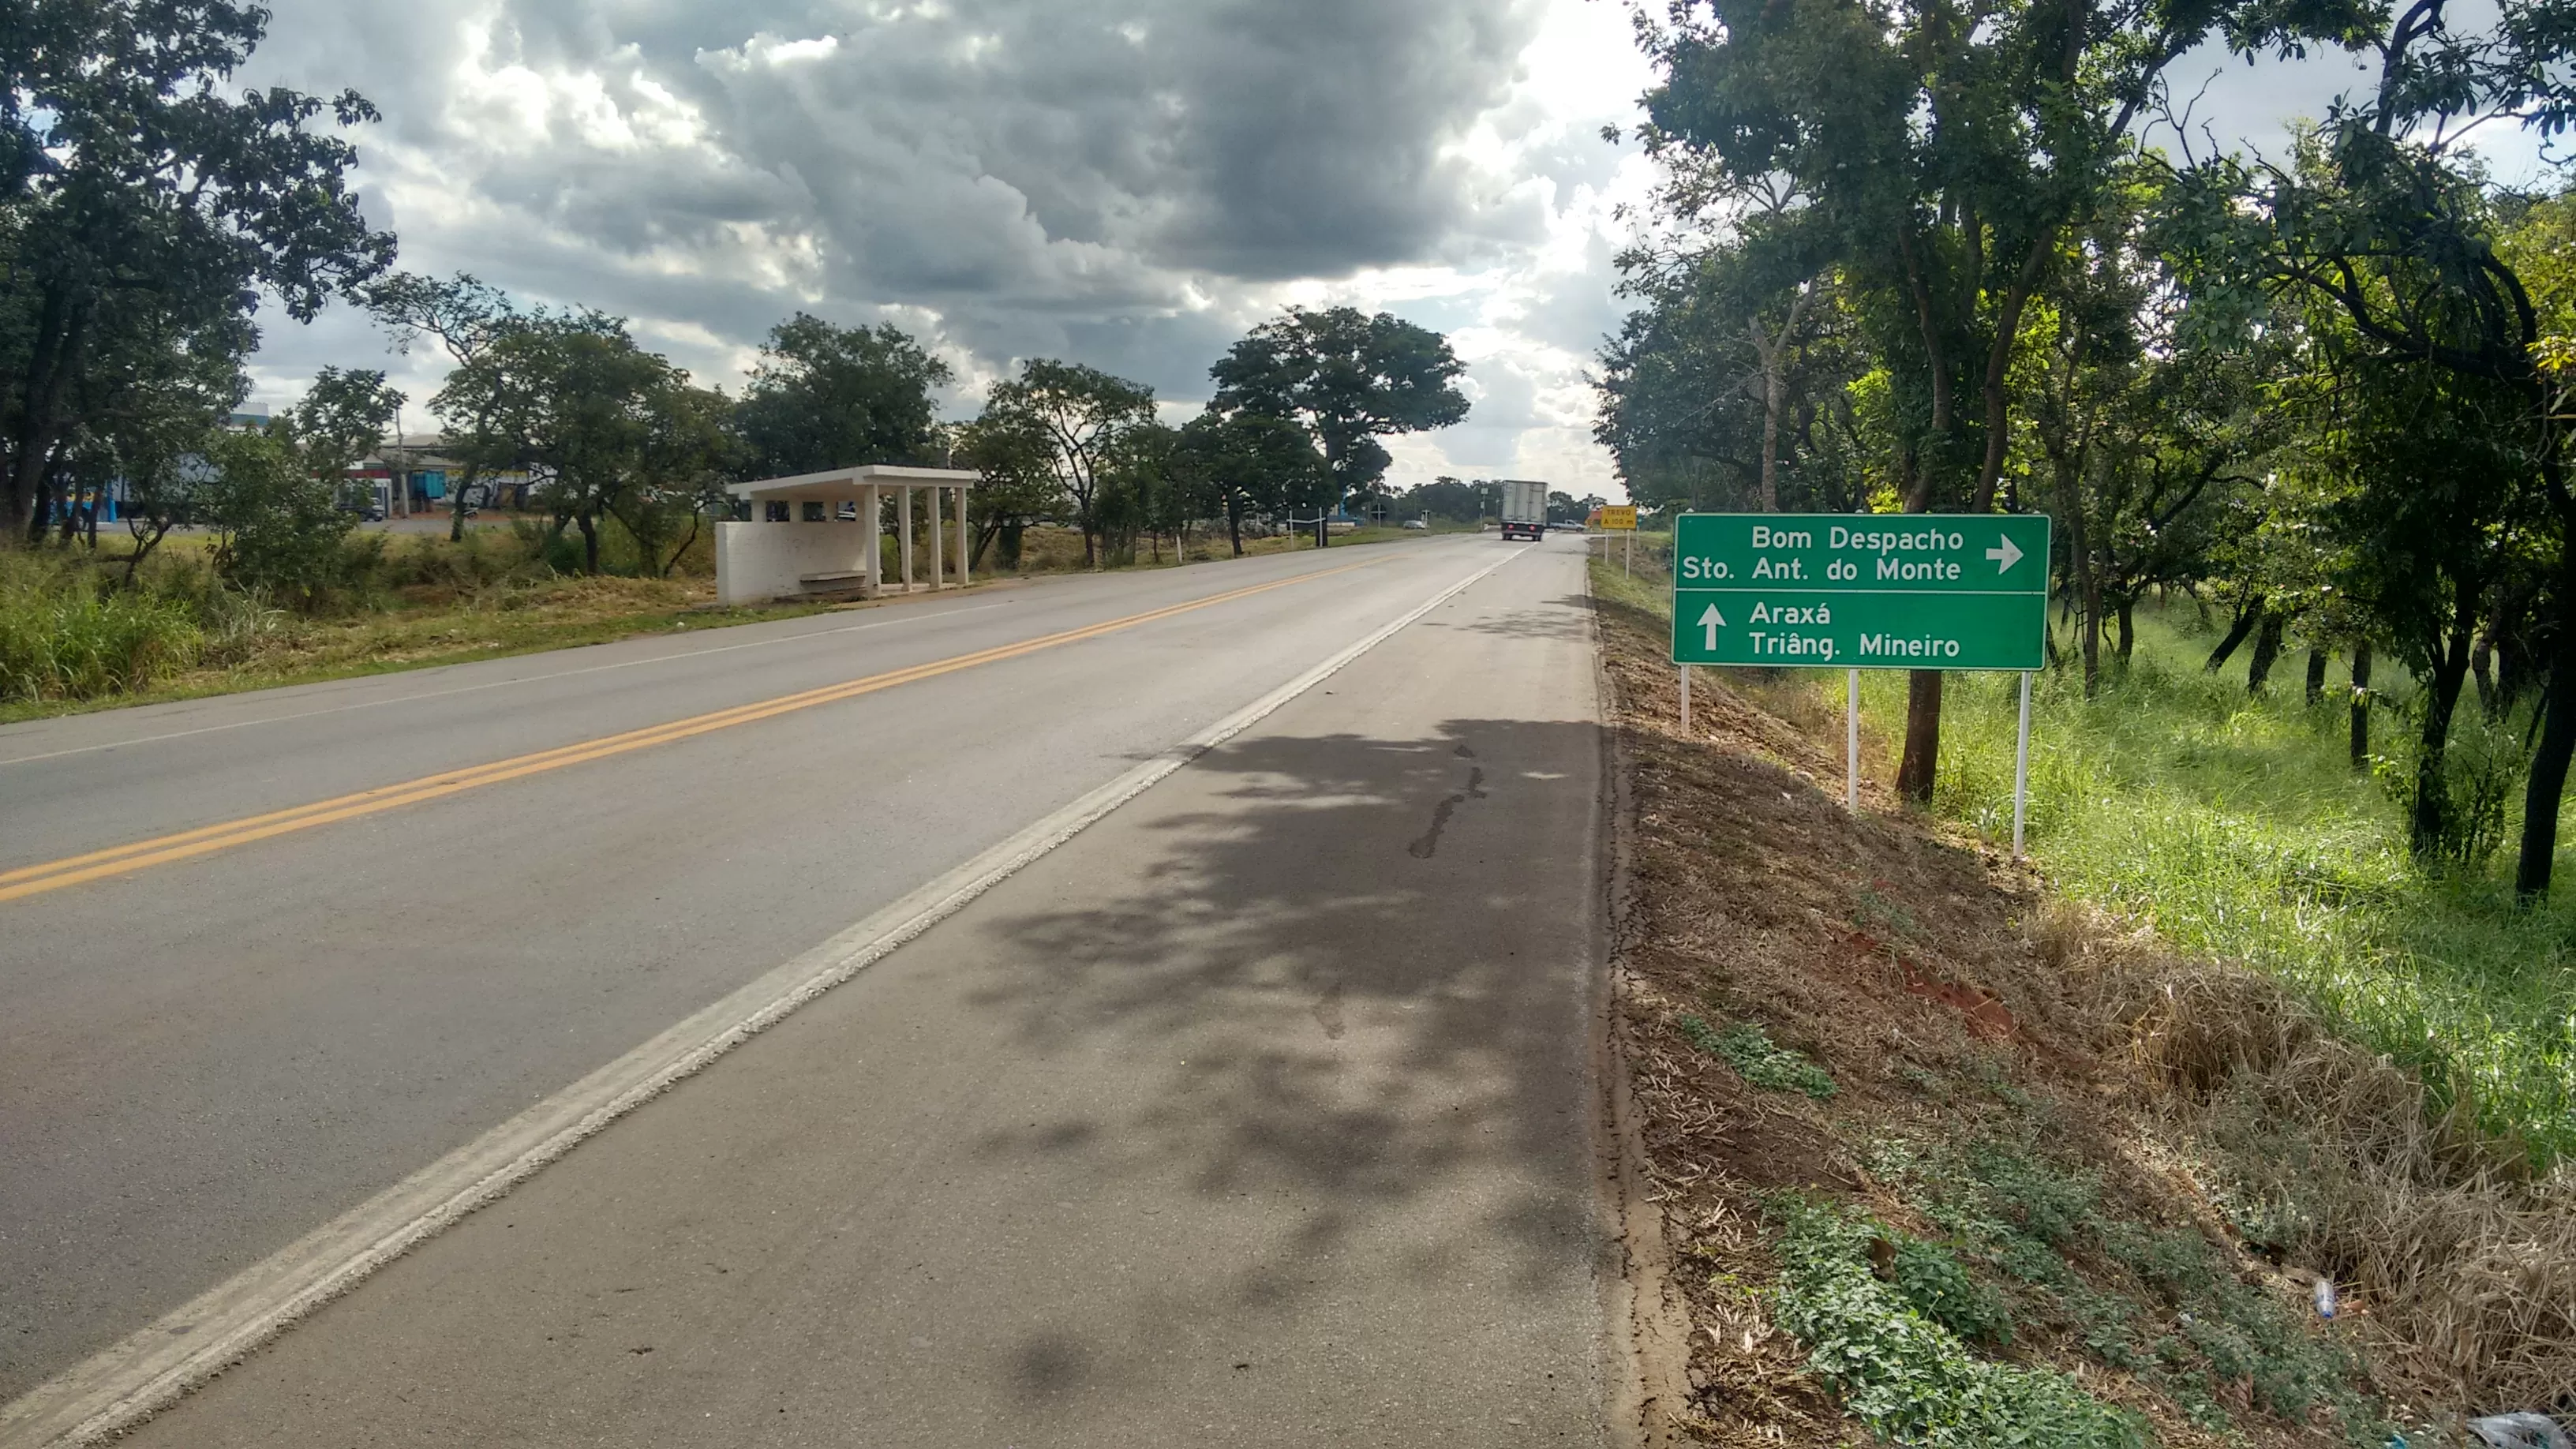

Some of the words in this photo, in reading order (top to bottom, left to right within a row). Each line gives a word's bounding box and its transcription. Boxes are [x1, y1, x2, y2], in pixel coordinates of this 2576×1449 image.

[1751, 526, 1812, 549] Bom
[1829, 526, 1964, 556] Despacho
[1682, 556, 1735, 579] Sto.
[1751, 556, 1809, 581] Ant.
[1826, 558, 1858, 581] do
[1875, 557, 1962, 581] Monte
[1749, 601, 1831, 625] Araxá
[1749, 632, 1840, 662] Triâng.
[1859, 633, 1960, 657] Mineiro
